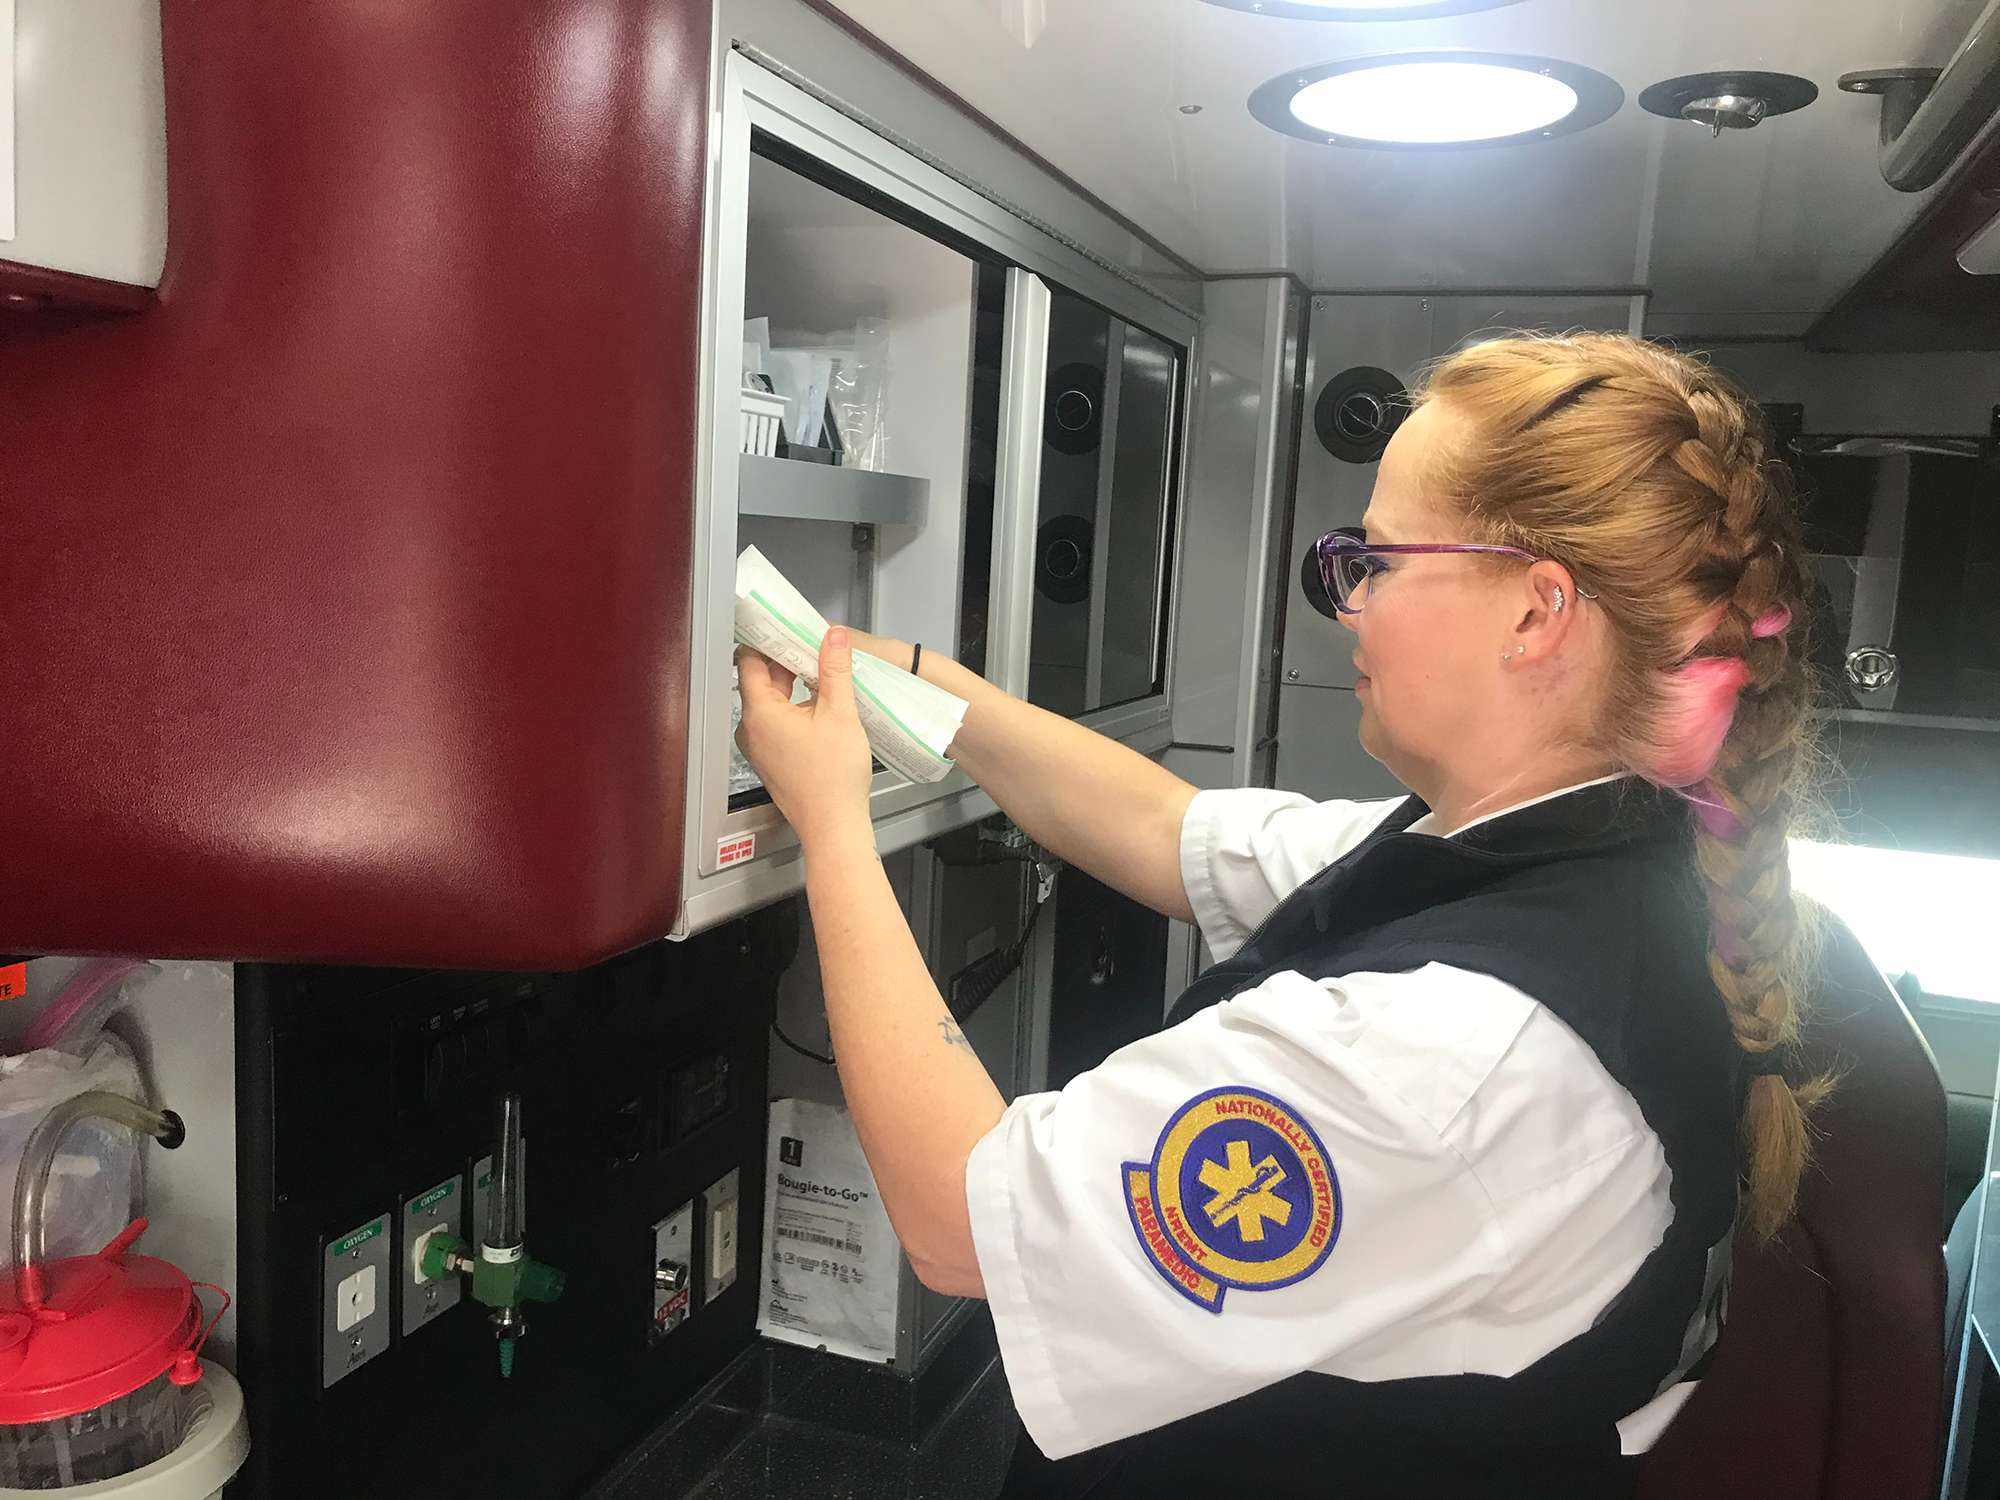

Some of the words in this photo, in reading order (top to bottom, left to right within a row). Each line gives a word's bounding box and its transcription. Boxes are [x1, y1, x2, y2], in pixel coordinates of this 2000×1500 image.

[419, 1187, 448, 1208] OXYGEN
[1215, 1099, 1312, 1153] NATIONALLY
[1307, 1157, 1330, 1249] CERTIFIED
[343, 1227, 374, 1250] OXYGEN
[1135, 1195, 1201, 1289] PARAMEDIC
